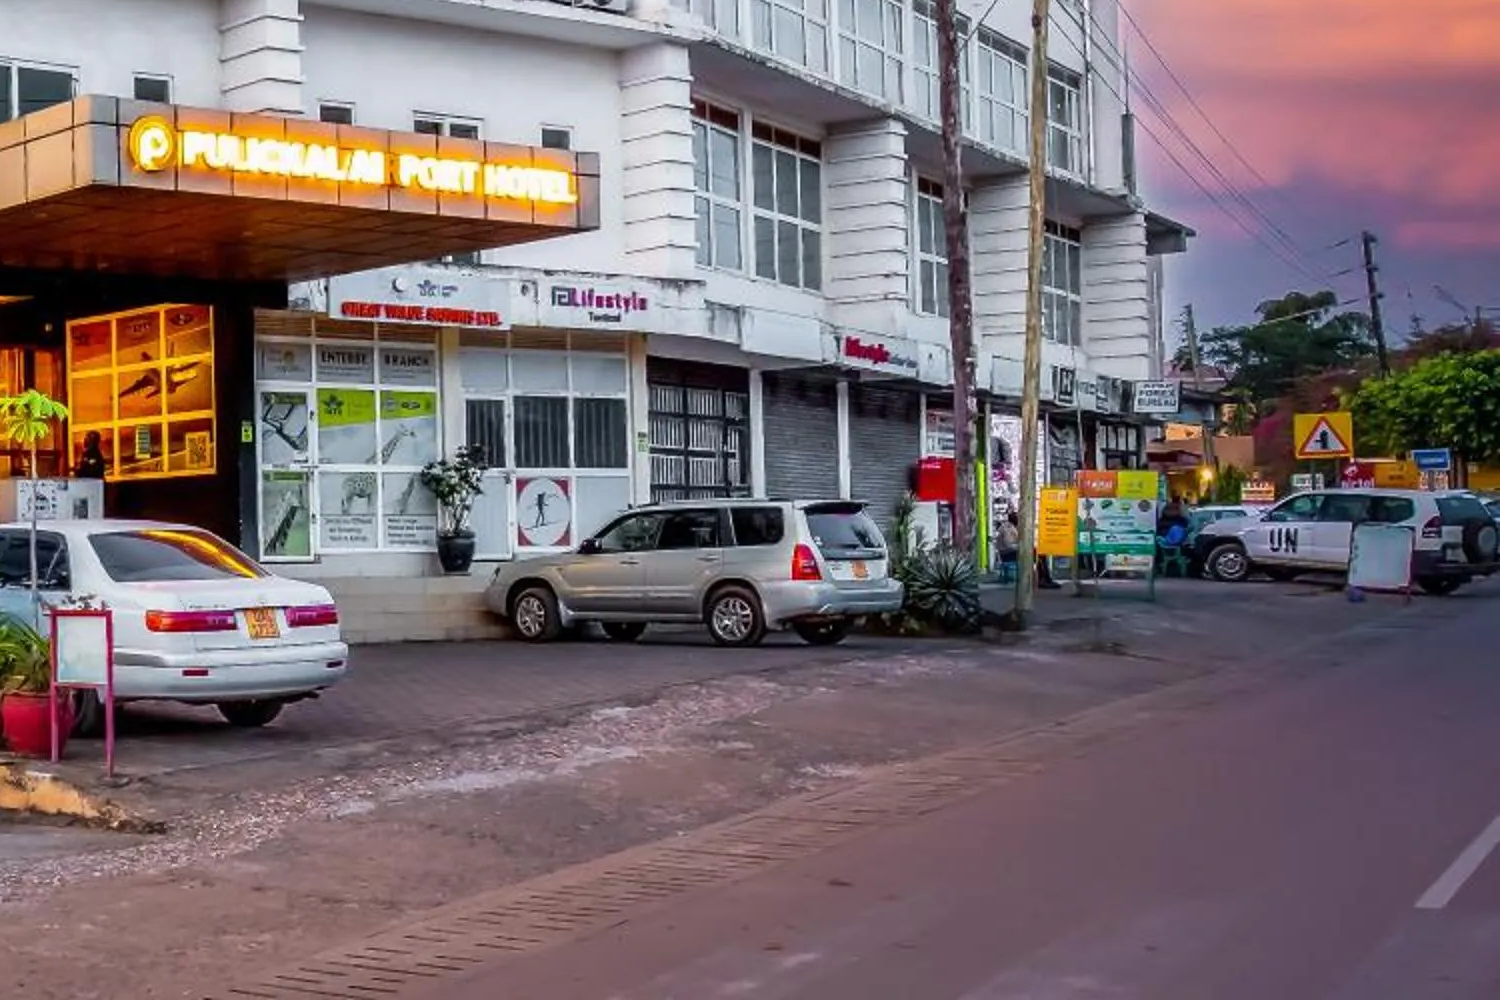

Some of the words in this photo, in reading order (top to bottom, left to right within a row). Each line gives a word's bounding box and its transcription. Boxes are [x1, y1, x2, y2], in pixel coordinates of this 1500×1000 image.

[182, 131, 349, 181] PULICKAL
[483, 163, 578, 203] HOTEL
[572, 286, 649, 314] Lifestyle
[1268, 528, 1299, 553] UN
